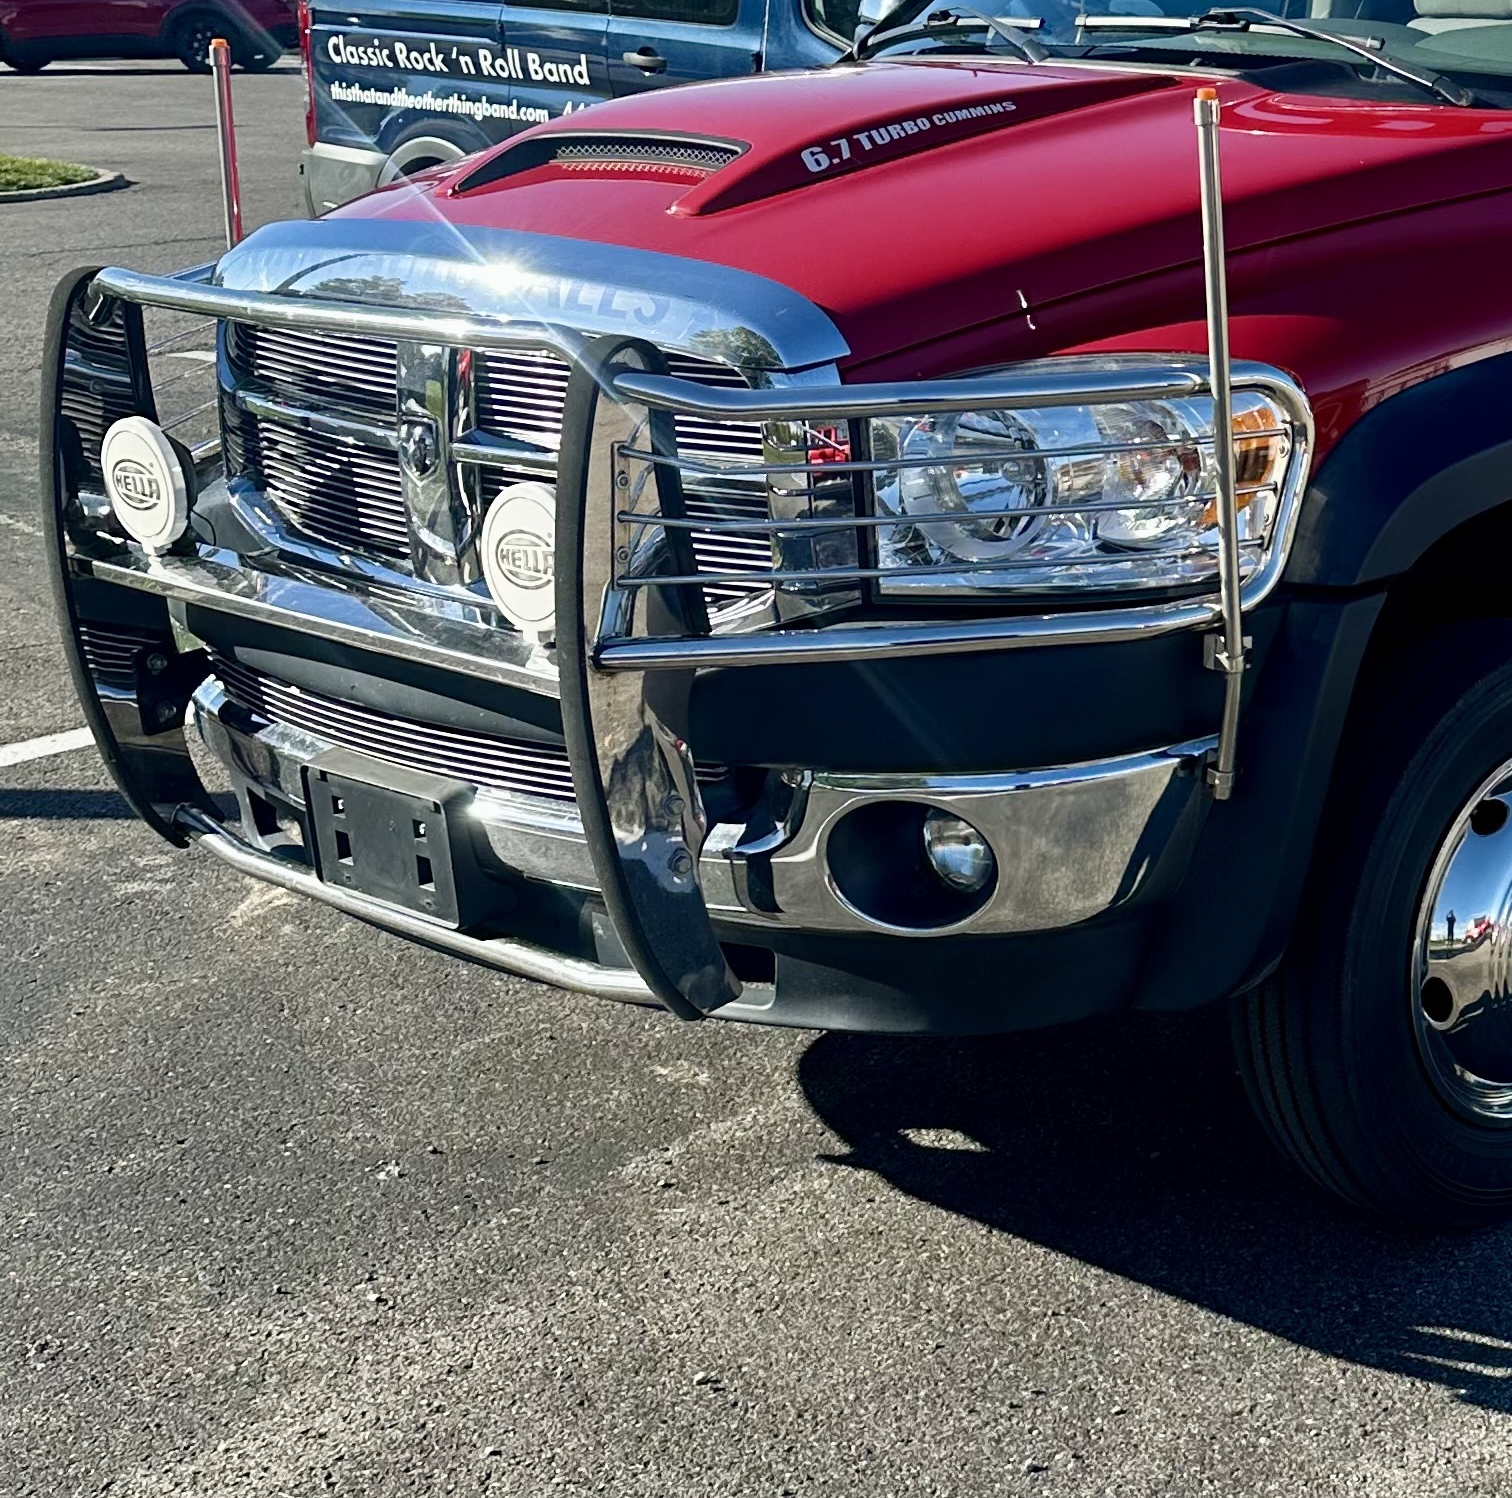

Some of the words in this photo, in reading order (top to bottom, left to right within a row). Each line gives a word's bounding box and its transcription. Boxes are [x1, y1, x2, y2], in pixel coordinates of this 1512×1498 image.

[327, 34, 394, 69] Classic
[394, 41, 449, 73] Rock
[478, 48, 524, 80] Roll
[526, 51, 591, 86] Band
[330, 80, 550, 123] thisthatandtheotherthingband.com
[800, 137, 851, 173] 6.7
[852, 117, 932, 152] TURBO
[931, 100, 1017, 127] CUMMINS
[115, 473, 161, 501] HELLA
[499, 547, 556, 577] HELLA
